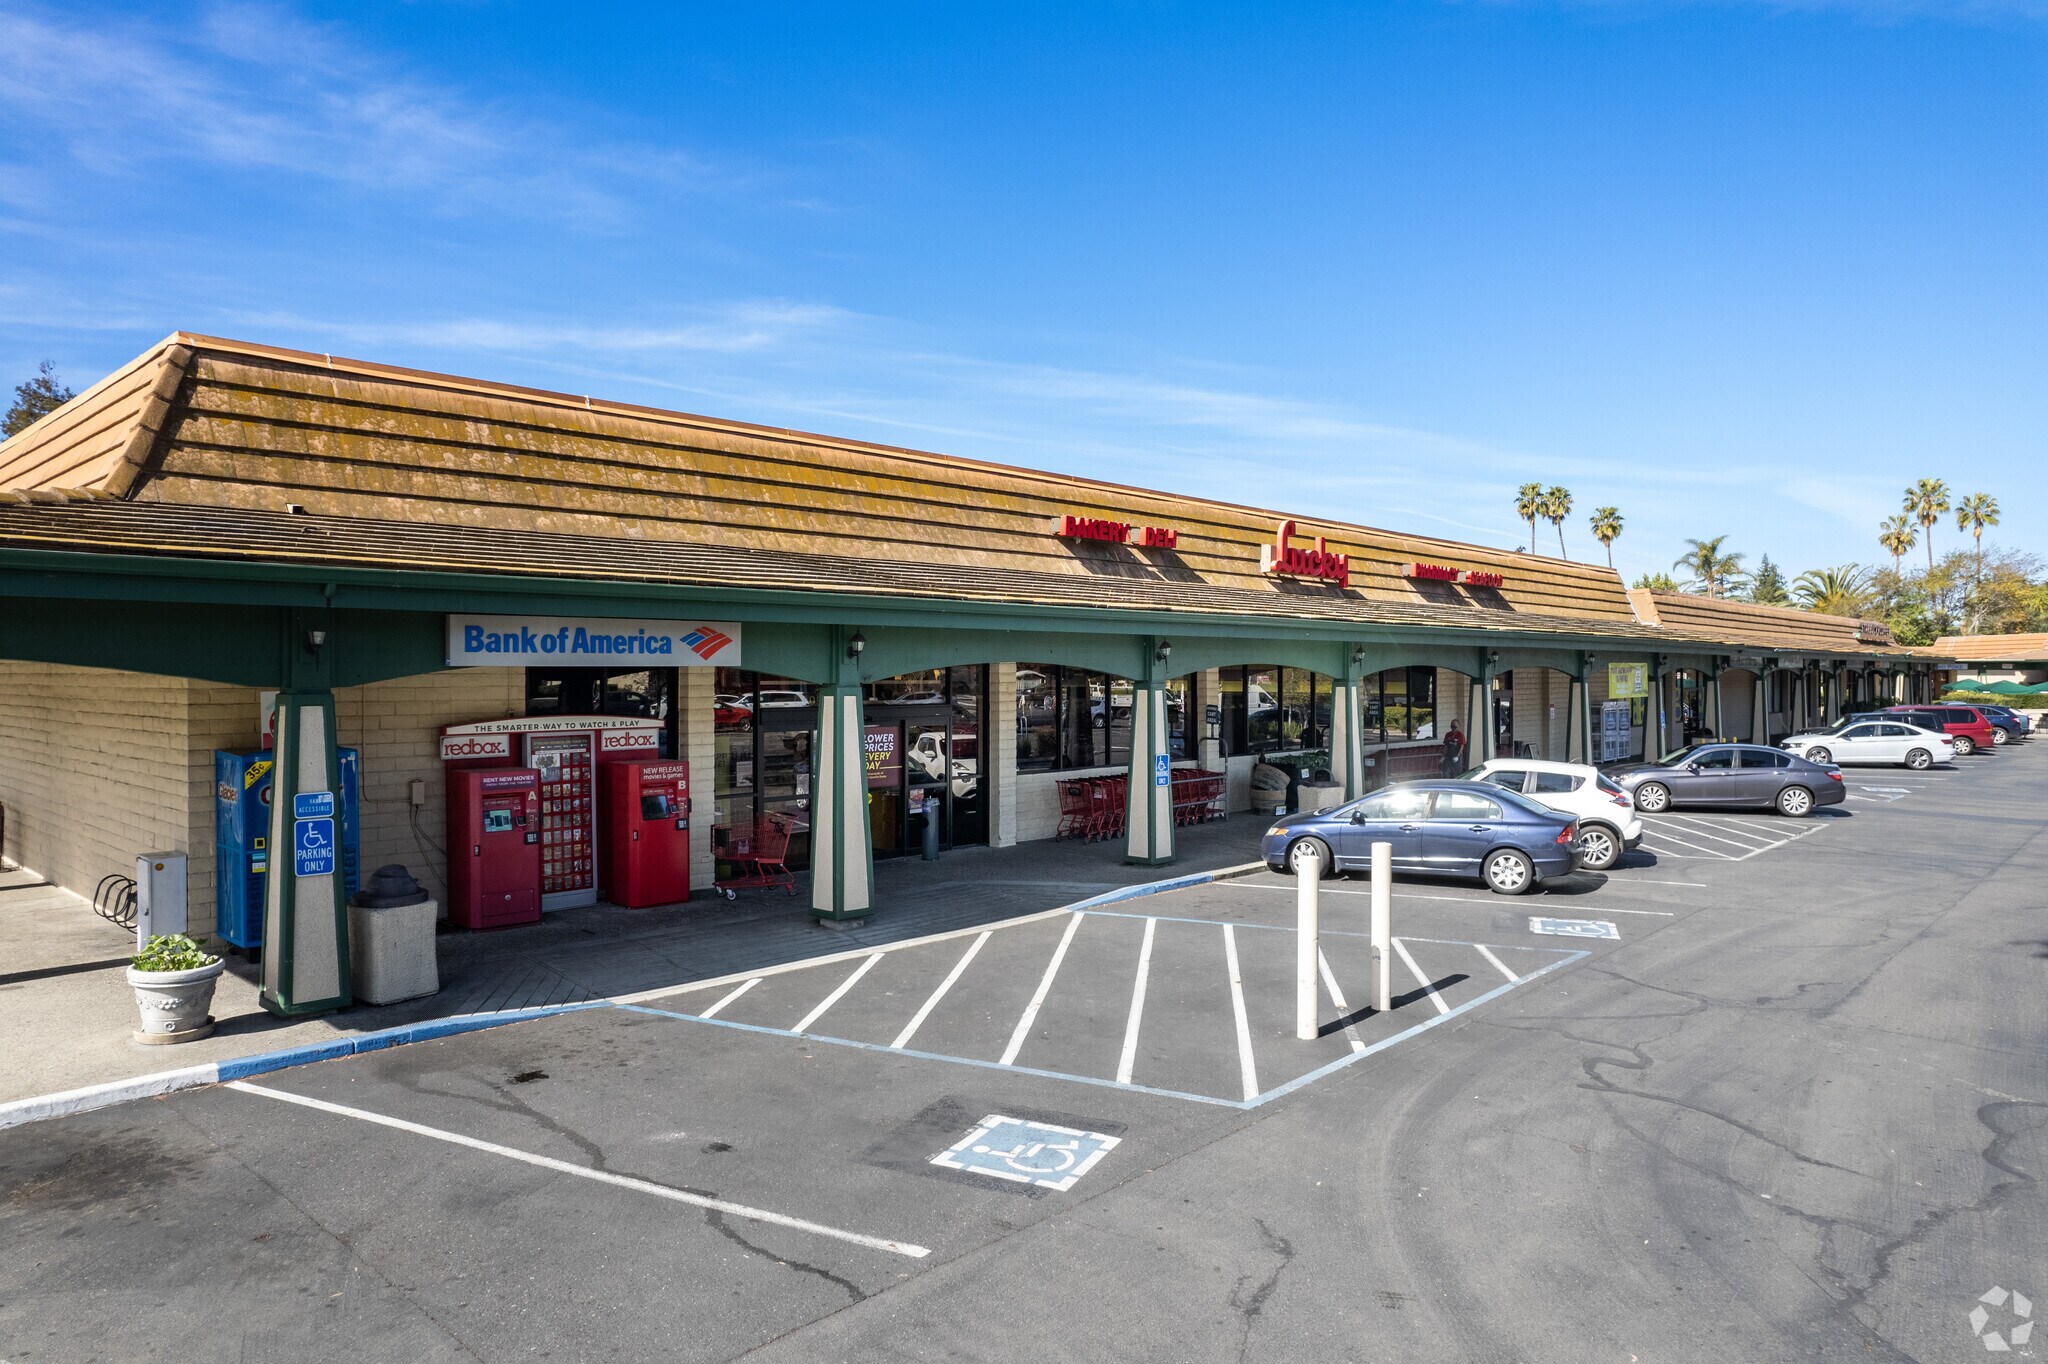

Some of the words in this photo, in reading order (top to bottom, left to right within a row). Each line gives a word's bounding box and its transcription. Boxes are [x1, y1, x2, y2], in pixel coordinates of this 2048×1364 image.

[1060, 515, 1130, 542] BAKERY
[1140, 527, 1177, 548] DELI
[1271, 520, 1348, 588] Lucky
[1410, 563, 1459, 581] PHARMACY
[1465, 571, 1503, 588] SEAFOOD
[464, 625, 538, 653] Bank
[540, 627, 569, 653] of
[571, 627, 672, 654] America
[246, 763, 265, 780] 35¢
[218, 782, 238, 802] Glacier
[678, 780, 686, 789] B
[528, 791, 537, 800] A
[298, 805, 330, 813] ACCESSIBLE
[297, 847, 332, 860] PARKING
[304, 860, 325, 872] ONLY
